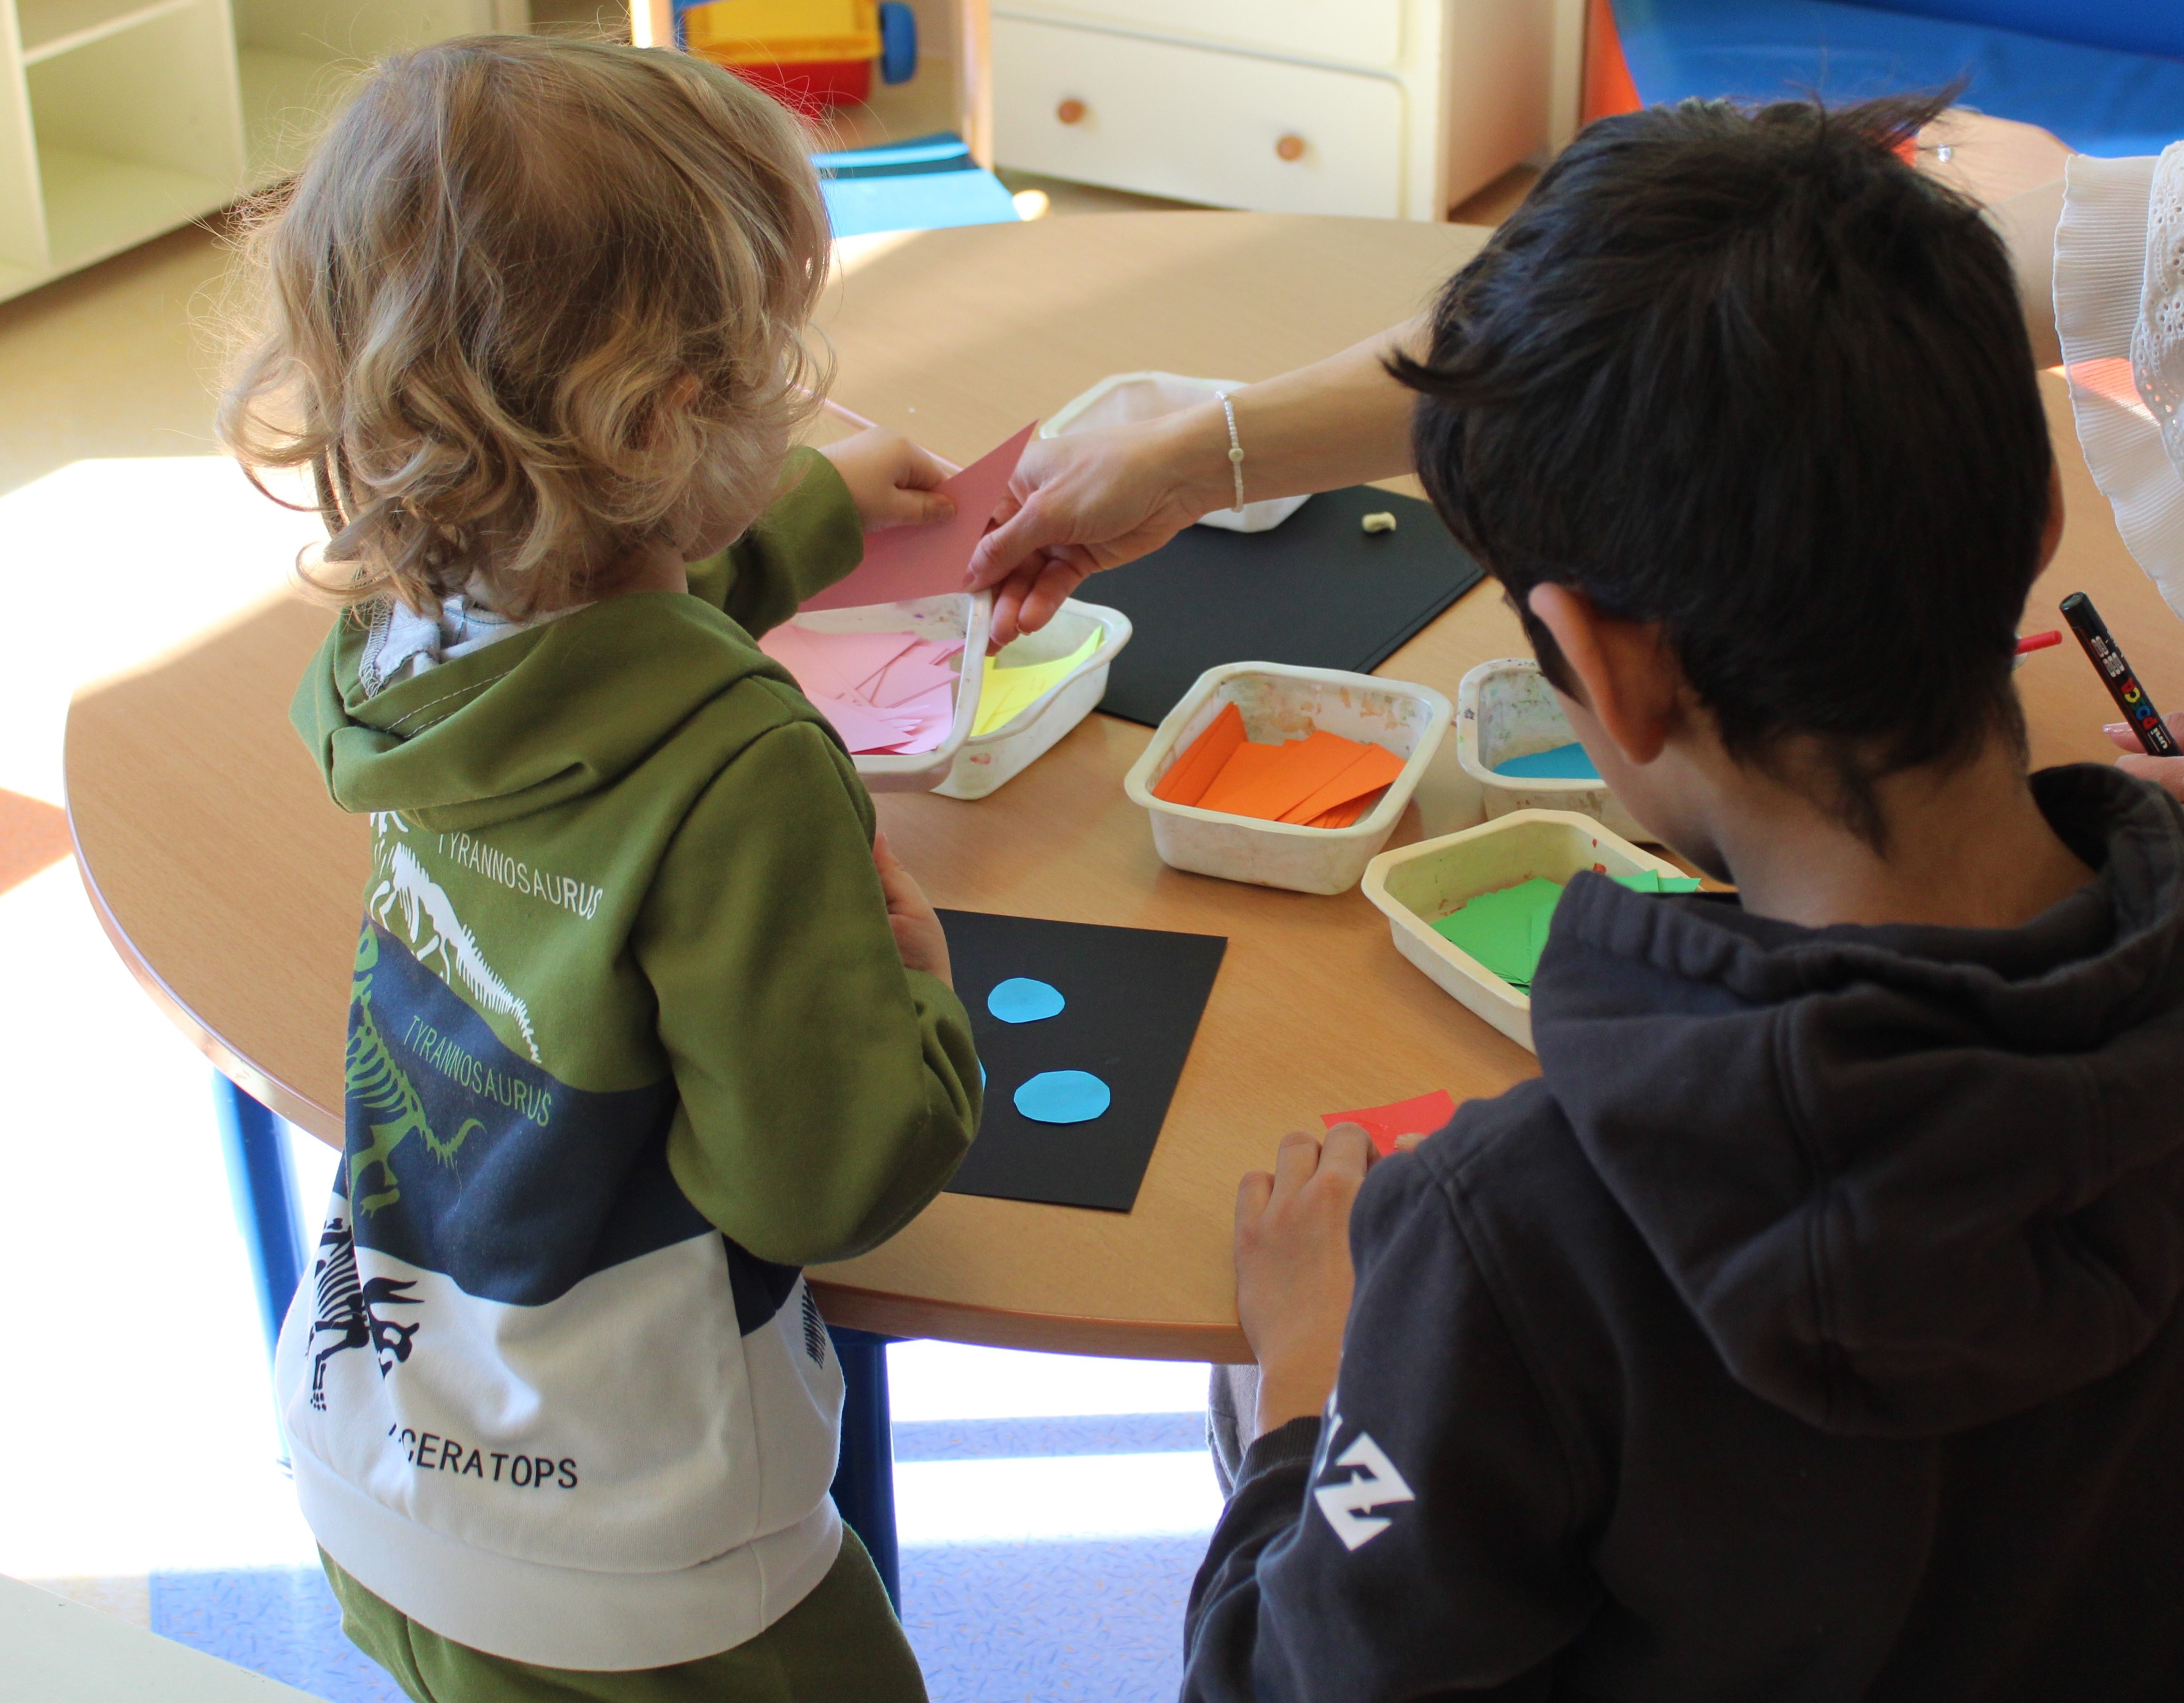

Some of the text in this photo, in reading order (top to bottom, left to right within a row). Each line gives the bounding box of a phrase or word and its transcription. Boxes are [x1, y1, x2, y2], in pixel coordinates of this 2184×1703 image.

[2121, 677, 2168, 749] uni POSCA
[438, 831, 603, 920] TYRANNOSAURUS
[402, 1015, 554, 1128] TYRANNOSAURUS
[1314, 1392, 1416, 1552] Z
